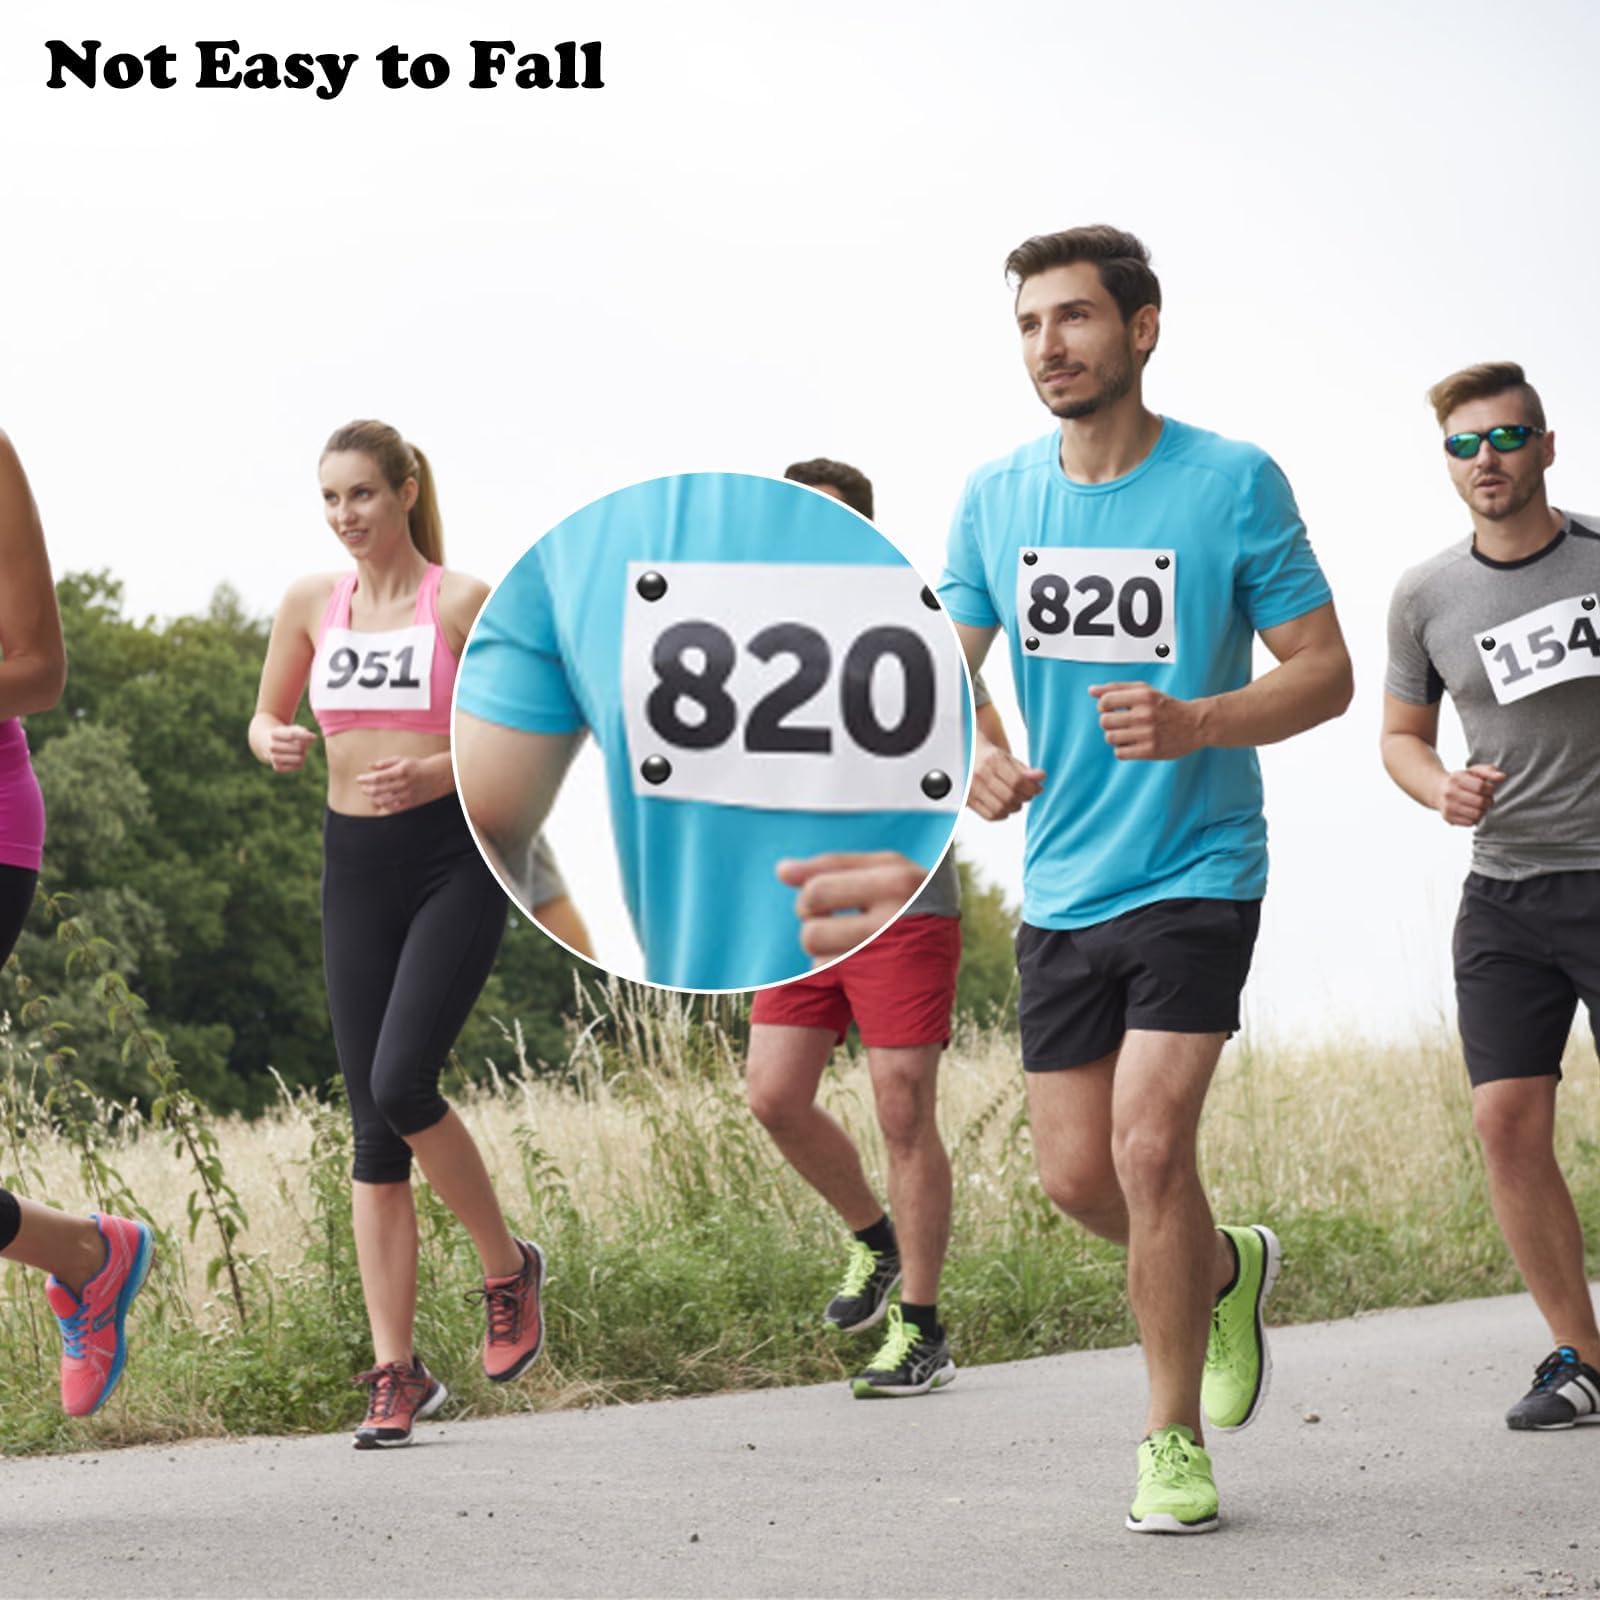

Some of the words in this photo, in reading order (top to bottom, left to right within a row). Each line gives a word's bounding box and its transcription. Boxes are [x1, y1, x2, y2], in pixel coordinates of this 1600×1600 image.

[1027, 573, 1164, 639] 820
[326, 645, 421, 689] 951
[1492, 616, 1600, 687] 154
[645, 619, 938, 758] 820
